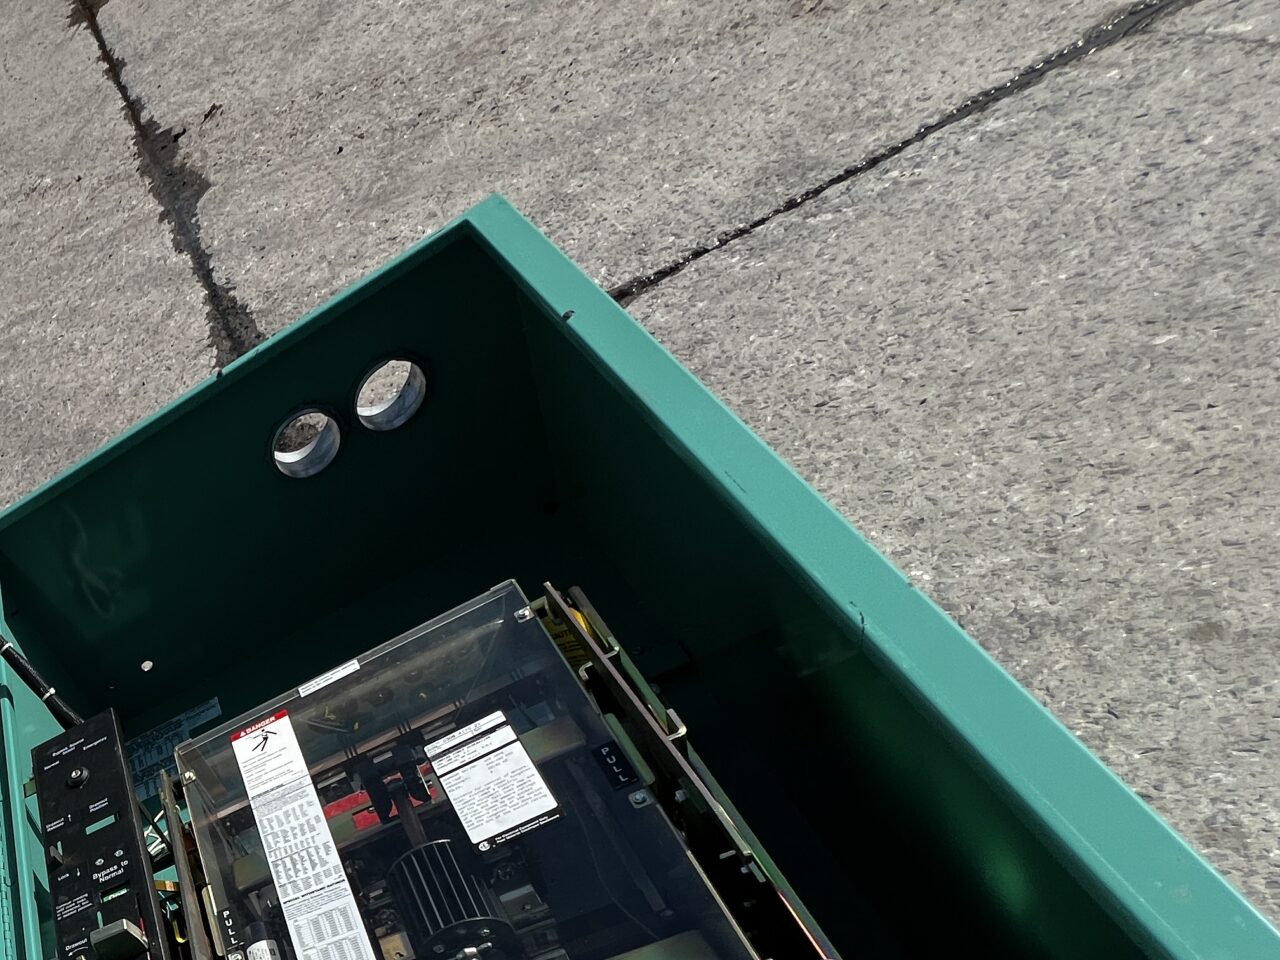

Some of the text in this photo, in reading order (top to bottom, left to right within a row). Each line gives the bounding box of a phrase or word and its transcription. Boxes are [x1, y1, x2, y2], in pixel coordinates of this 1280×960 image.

[245, 716, 275, 733] DANGER
[601, 747, 628, 781] PULL
[91, 858, 128, 880] Bypass to
[98, 867, 124, 883] Normal
[223, 911, 238, 944] PULL
[64, 937, 88, 951] Drawout
